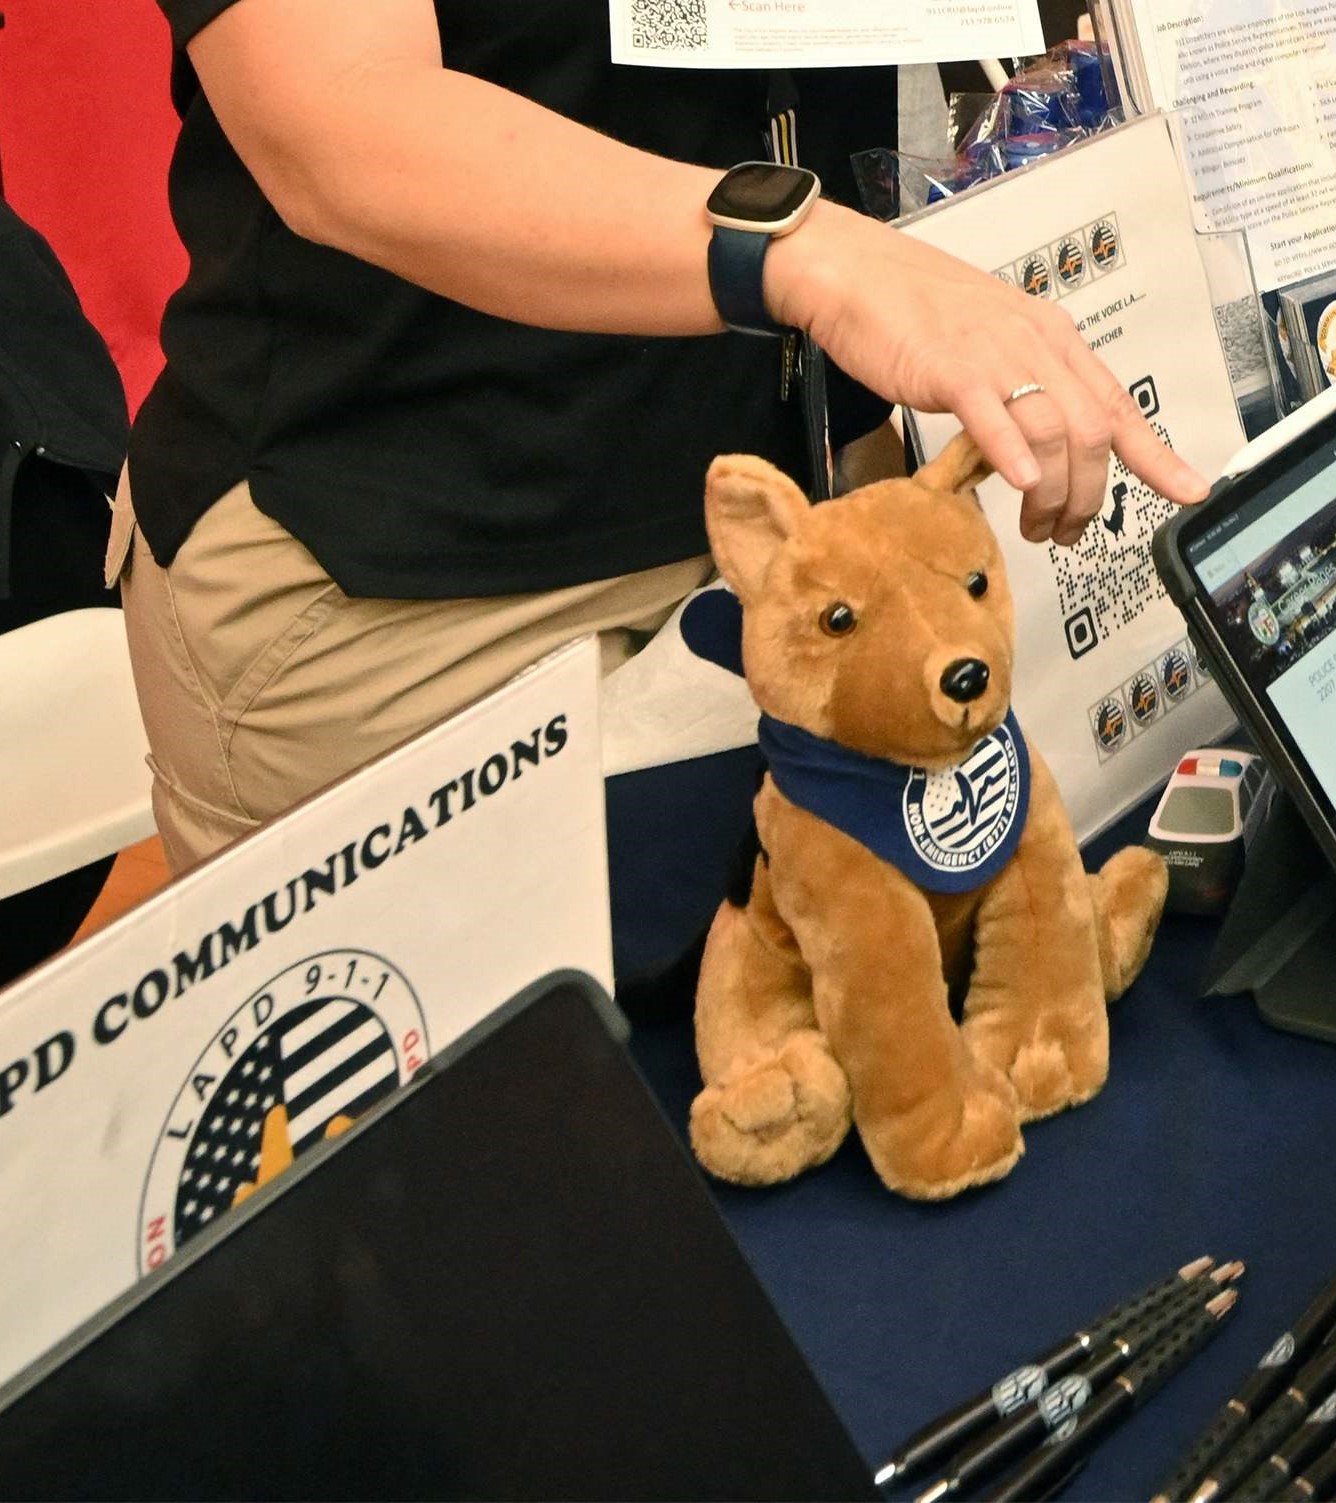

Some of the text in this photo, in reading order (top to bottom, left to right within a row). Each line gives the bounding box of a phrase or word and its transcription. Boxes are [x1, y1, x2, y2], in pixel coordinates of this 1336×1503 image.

[742, 0, 805, 12] Scan Here
[1086, 312, 1100, 327] THE
[1101, 302, 1123, 319] VOICE
[1307, 657, 1336, 687] POLICE
[908, 802, 981, 867] NON-EMERGENCY
[92, 713, 570, 1048] COMMUNICATIONS
[168, 959, 390, 1139] LAPD 9-1-1
